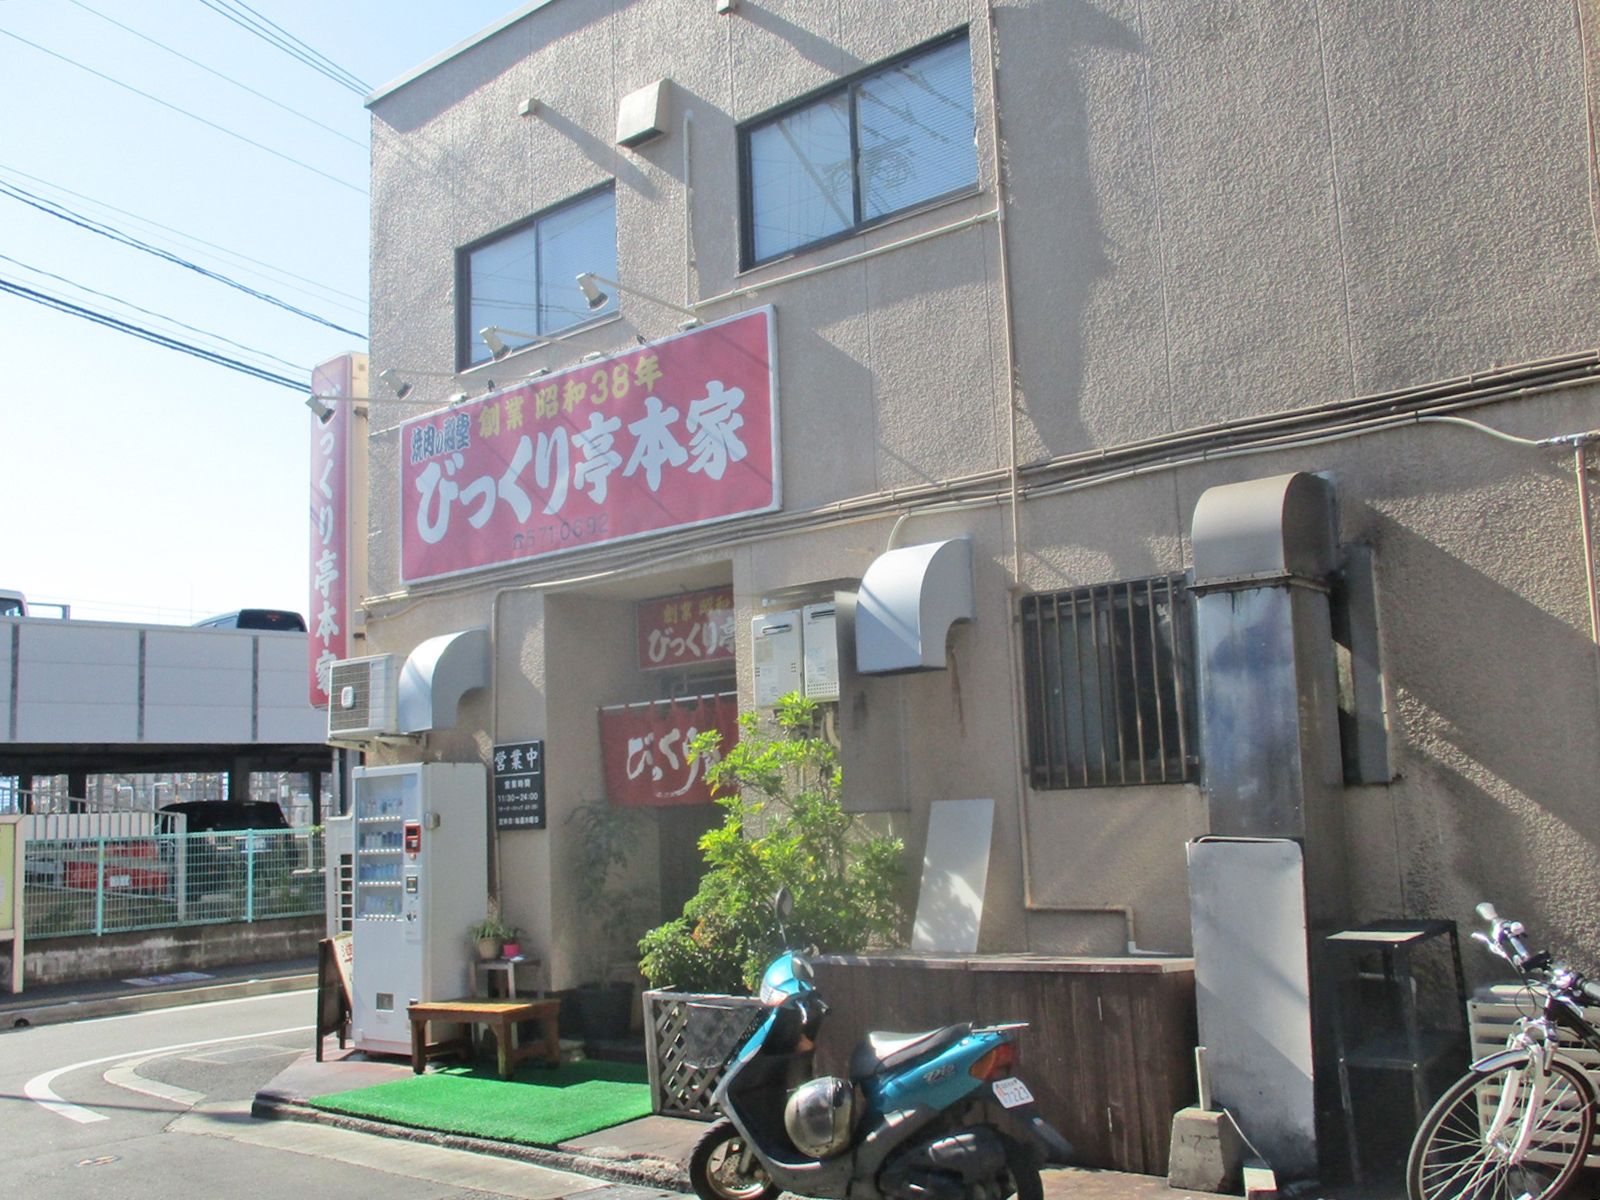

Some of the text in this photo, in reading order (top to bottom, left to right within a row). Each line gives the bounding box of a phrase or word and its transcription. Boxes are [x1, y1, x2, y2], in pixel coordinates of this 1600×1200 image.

[478, 355, 663, 439] 創業 昭和38年
[414, 380, 747, 544] びっくり亭本家
[494, 747, 538, 772] 営業中
